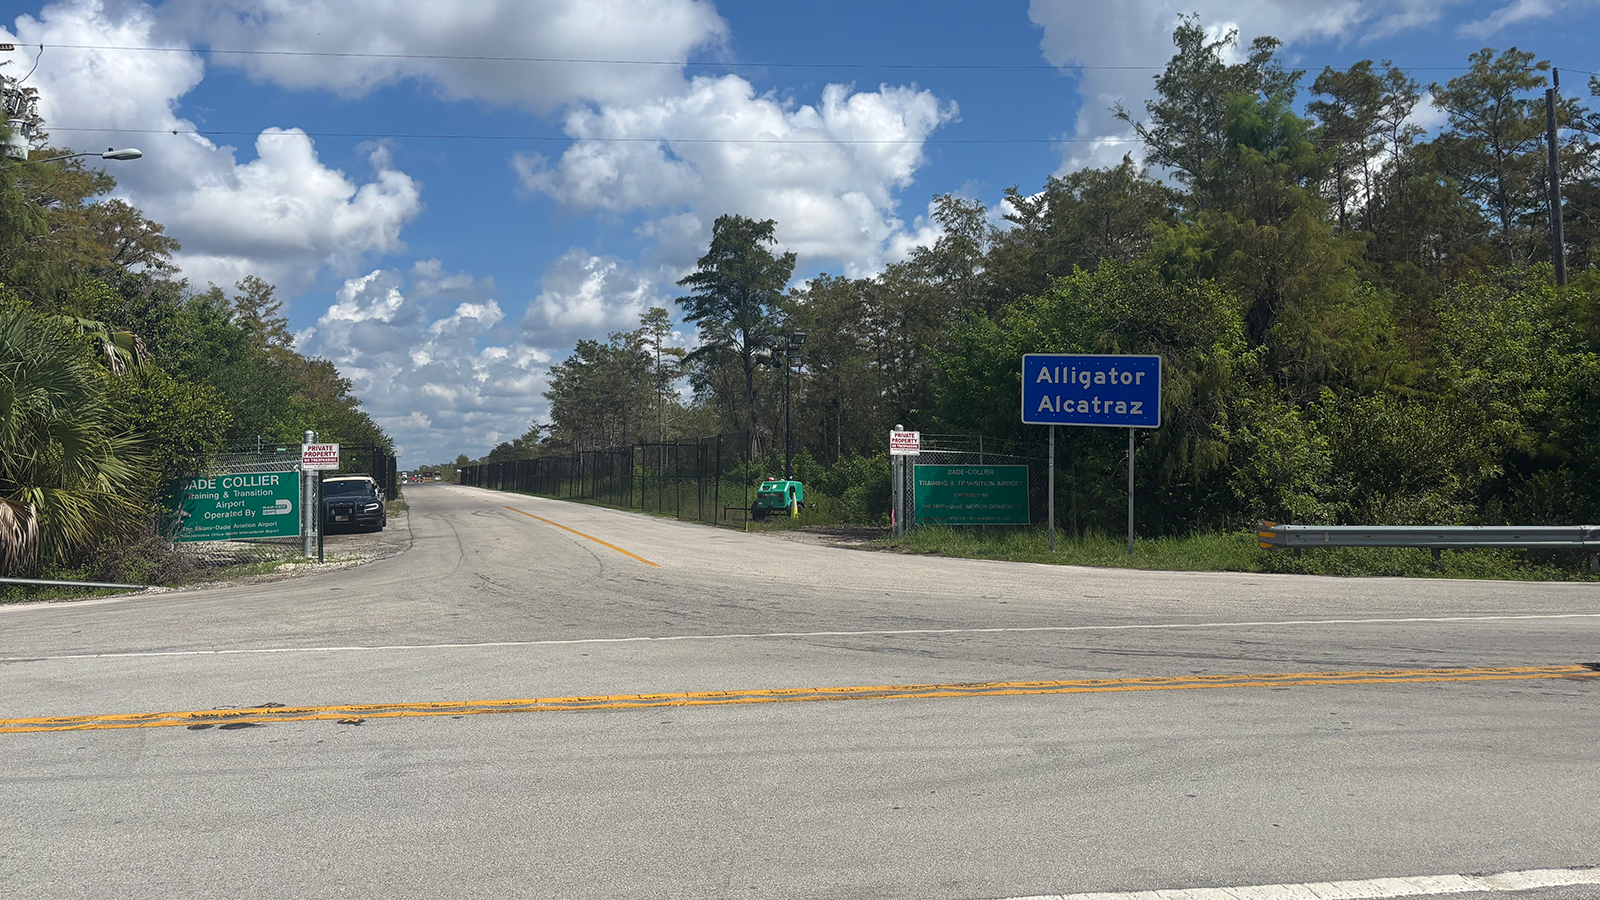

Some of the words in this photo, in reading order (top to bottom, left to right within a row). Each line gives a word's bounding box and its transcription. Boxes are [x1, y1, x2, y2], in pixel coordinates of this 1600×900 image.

[1036, 366, 1146, 390] Alligator
[1037, 395, 1143, 415] Alcatraz
[222, 474, 280, 489] COLLIER
[188, 491, 220, 500] Training
[233, 488, 273, 498] Transition
[216, 499, 246, 510] Airport
[204, 510, 243, 520] Operated
[245, 509, 256, 518] By
